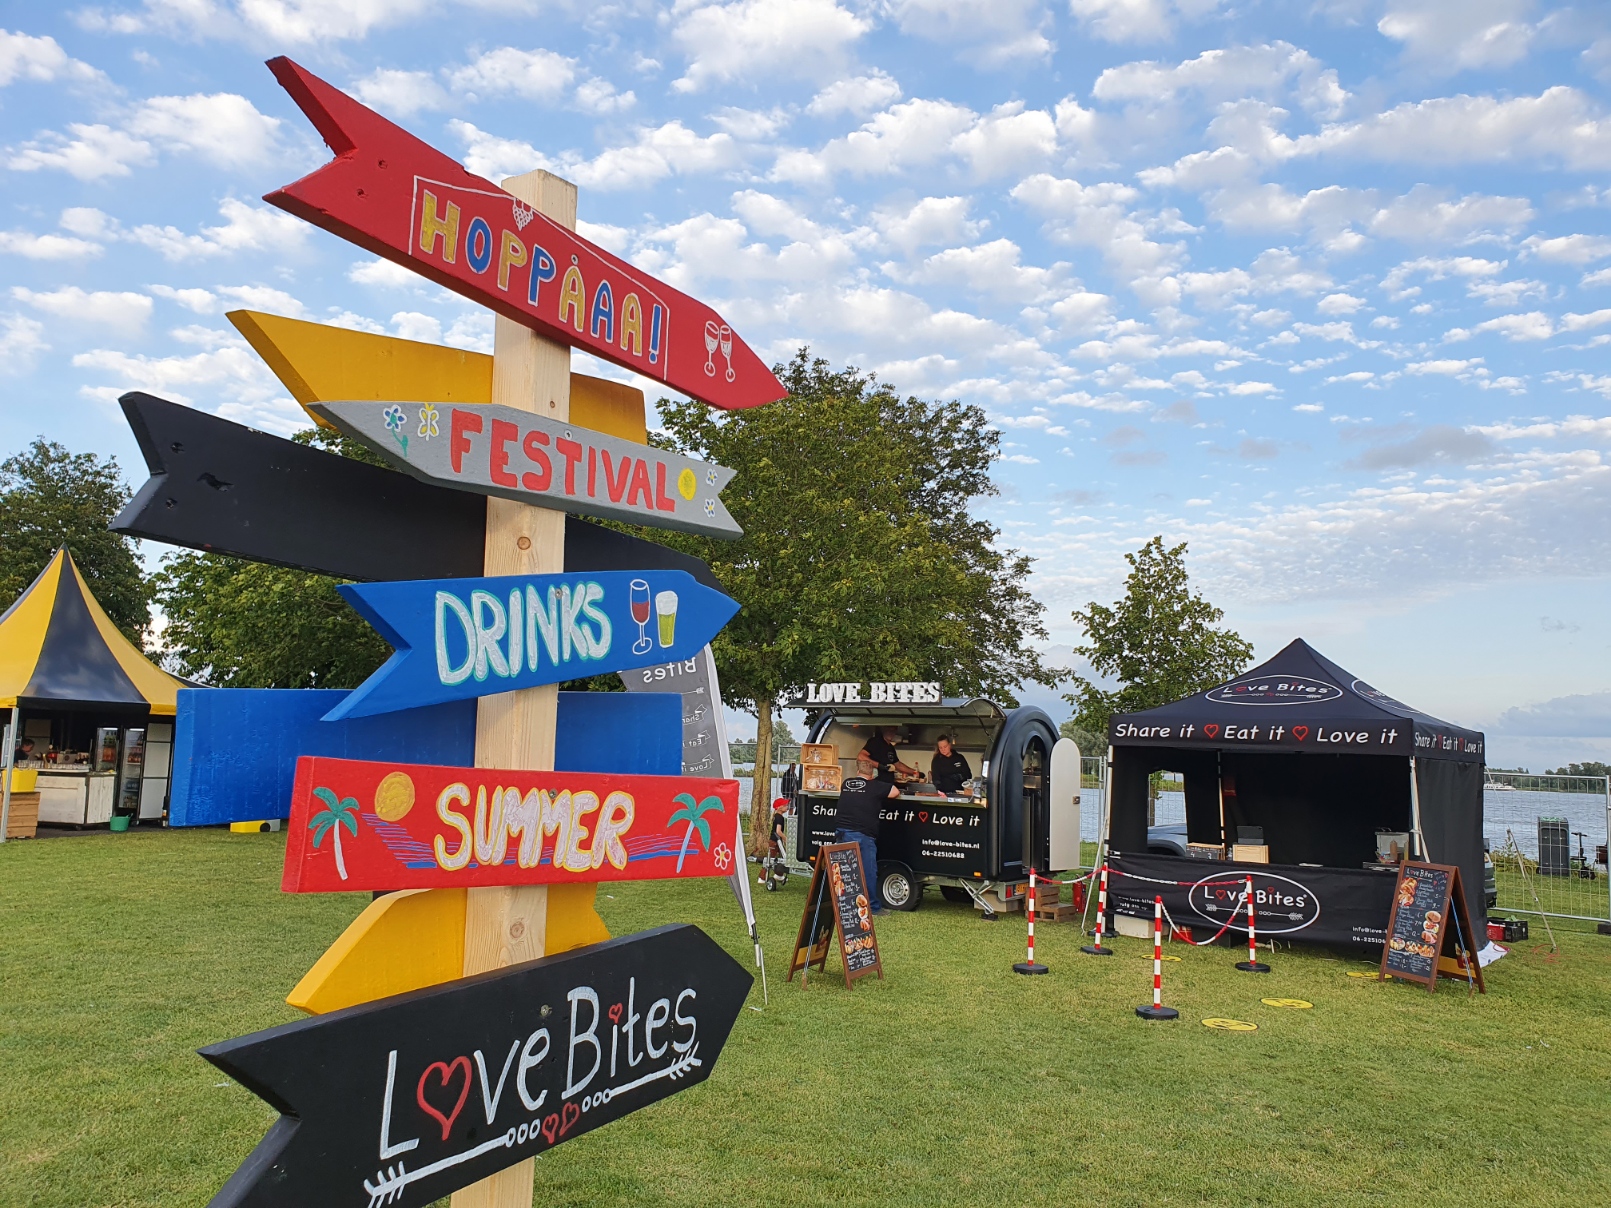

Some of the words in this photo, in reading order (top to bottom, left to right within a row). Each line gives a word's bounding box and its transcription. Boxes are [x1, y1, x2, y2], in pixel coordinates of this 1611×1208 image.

[450, 408, 676, 513] FESTIVAL
[434, 580, 613, 686] DRINKS
[806, 682, 861, 703] LOVE
[870, 682, 940, 702] BITES
[1222, 685, 1269, 693] Love
[1276, 681, 1328, 694] Bites
[1115, 723, 1171, 738] Share
[1179, 723, 1196, 739] it
[1224, 725, 1260, 740] Eat
[1268, 725, 1286, 741] it
[1316, 727, 1369, 744] Love
[1380, 728, 1399, 744] it
[1414, 731, 1431, 748] Share
[1430, 733, 1437, 749] it
[1442, 736, 1453, 750] Eat
[1453, 737, 1459, 751] it
[1464, 739, 1477, 753] Love
[1477, 740, 1483, 754] it
[433, 782, 635, 873] SUMMER
[878, 809, 900, 820] Eat
[904, 810, 915, 822] it
[932, 812, 964, 826] Love
[969, 815, 980, 827] it
[1204, 885, 1248, 902] Love
[1255, 887, 1305, 908] Bites
[379, 1025, 549, 1161] Love
[560, 976, 698, 1101] Bites
